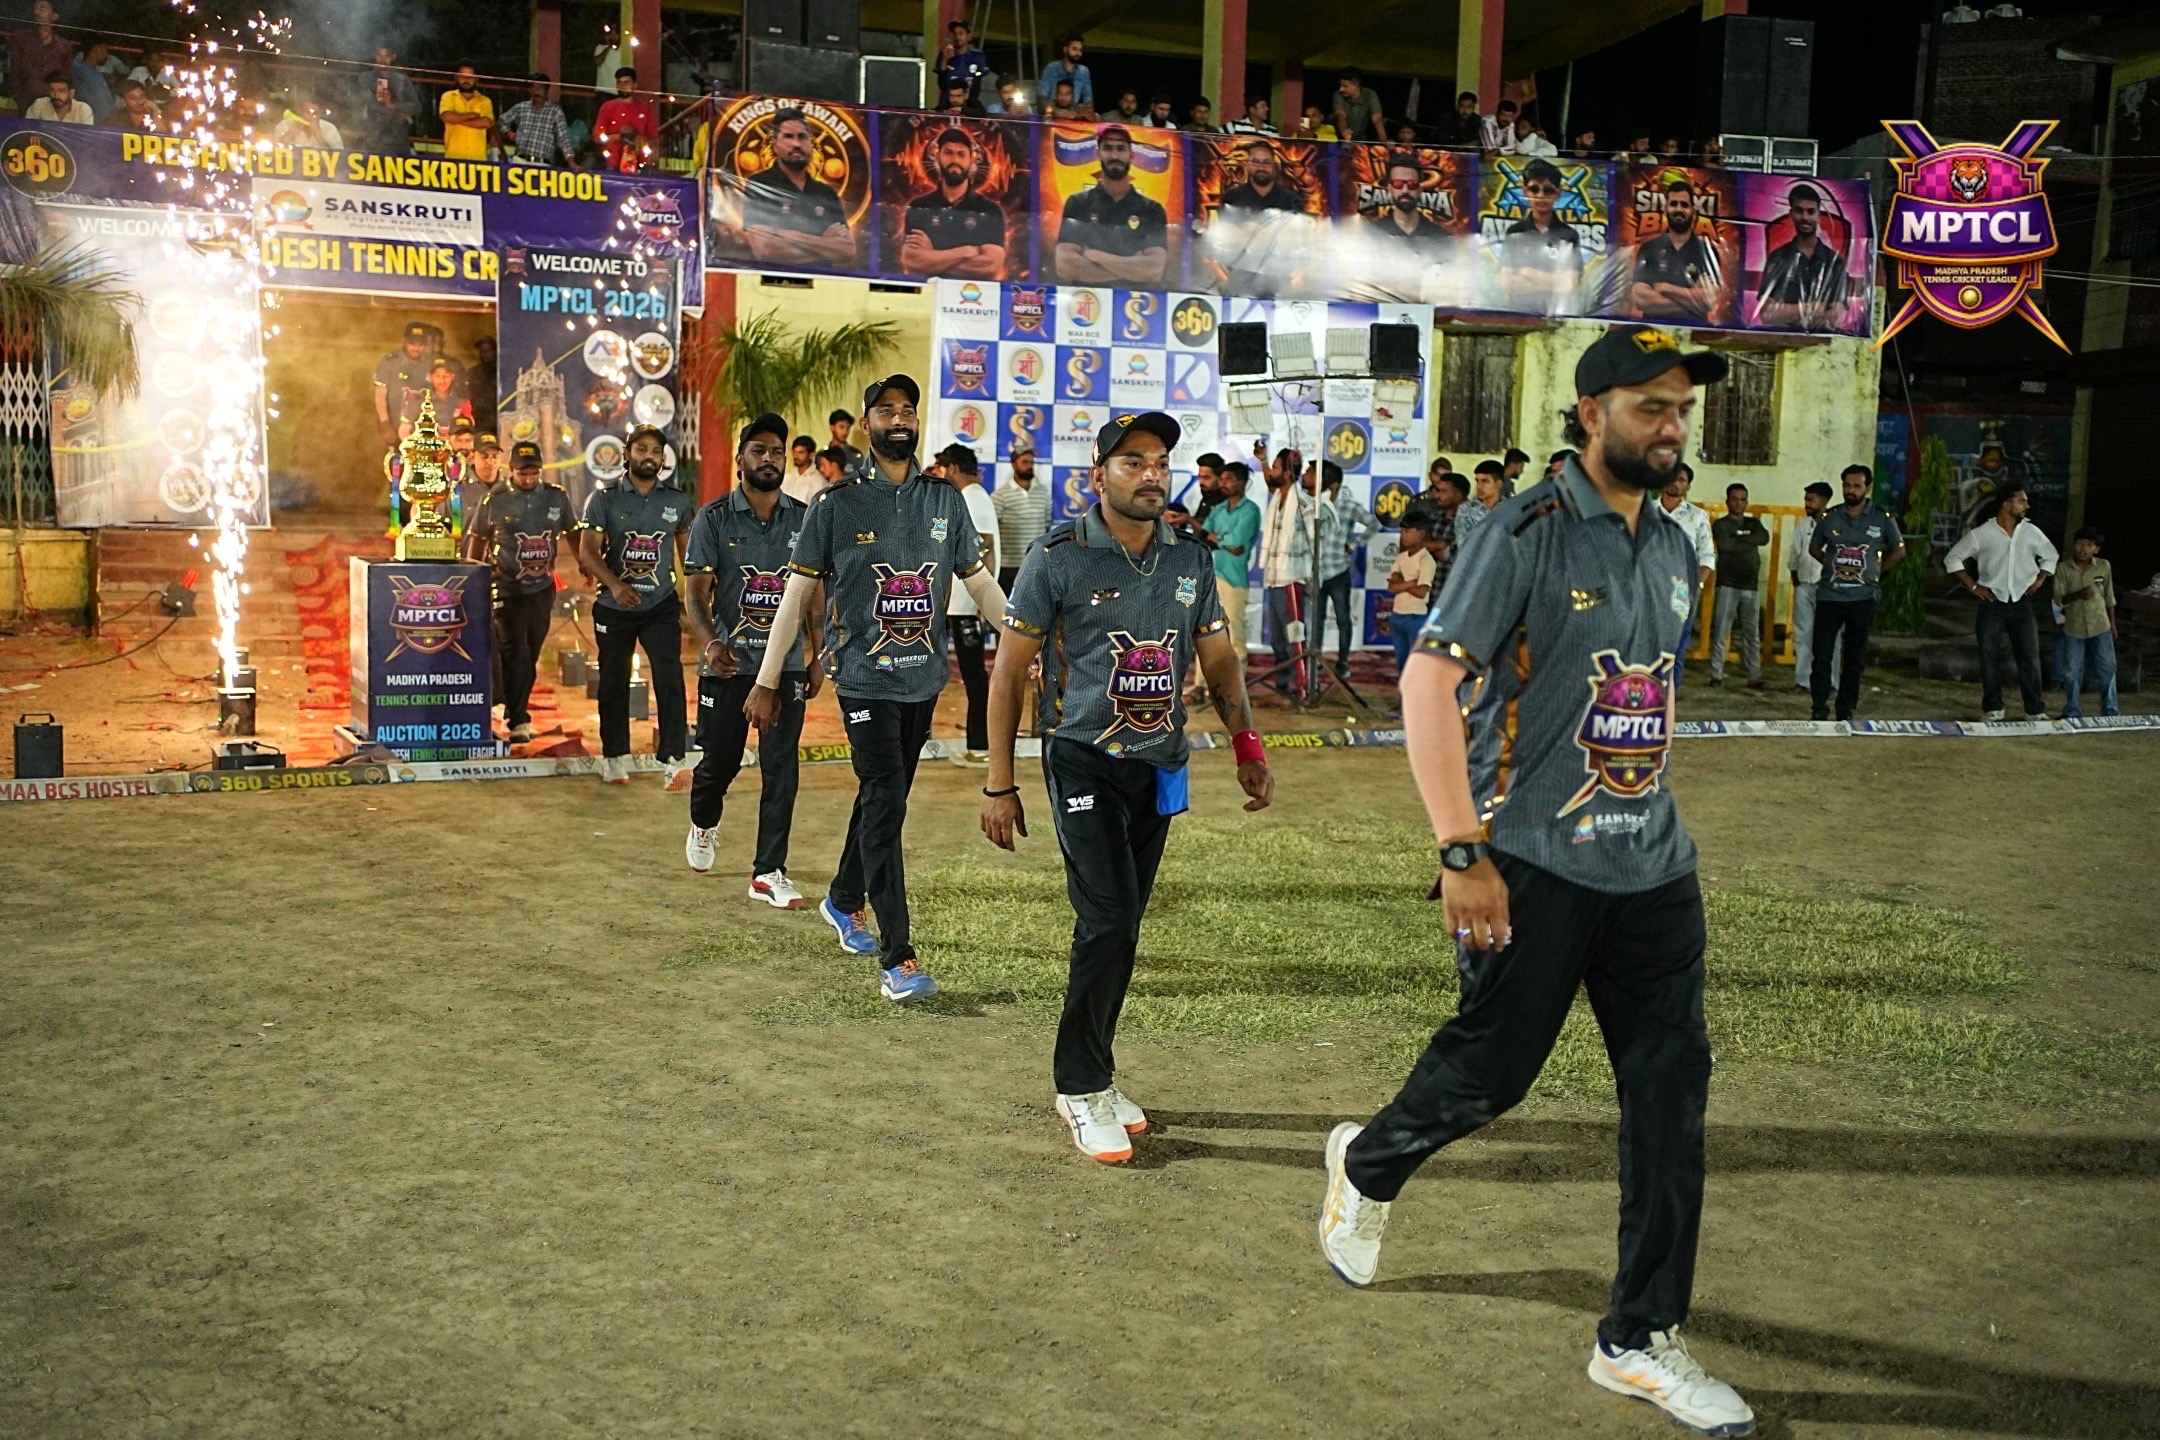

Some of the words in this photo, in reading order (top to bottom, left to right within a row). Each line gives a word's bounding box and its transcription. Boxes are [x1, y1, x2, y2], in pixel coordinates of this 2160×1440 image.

[728, 98, 775, 134] KINGS
[802, 102, 854, 142] AWARI
[8, 145, 66, 182] 360
[122, 133, 293, 176] PRESENTED
[302, 150, 339, 178] BY
[348, 153, 500, 193] SANSKRUTI
[508, 167, 608, 202] SCHOOL
[325, 198, 472, 221] SANSKRUTI
[637, 211, 680, 225] MPTCL
[77, 217, 183, 238] WELCOME
[349, 242, 456, 279] TENNIS
[532, 253, 621, 275] WELCOME
[624, 260, 647, 277] TO
[521, 285, 598, 315] MPTCL
[604, 290, 666, 319] 2026
[1013, 304, 1044, 316] MPTCL
[943, 306, 998, 317] SANSKRUTI
[1174, 306, 1213, 336] 360
[1111, 378, 1165, 388] SANSKRUTI
[1329, 430, 1365, 459] 360
[1373, 447, 1421, 455] SANSKRUTI
[625, 550, 657, 560] MPTCL
[881, 599, 930, 613] MPTCL
[397, 609, 461, 623] MPTCL
[387, 674, 428, 686] MADHYA
[429, 673, 472, 685] PRADESH
[1118, 676, 1173, 692] MPTCL
[375, 694, 409, 706] TENNIS
[410, 694, 448, 705] CRICKET
[449, 693, 484, 705] LEAGUE
[377, 725, 437, 743] AUCTION
[441, 723, 481, 740] 2026
[1592, 715, 1666, 741] MPTCL
[1263, 733, 1324, 748] SPORTS
[469, 746, 496, 759] LEAGUE
[441, 765, 527, 776] SANSKRUTI
[220, 776, 262, 792] 360
[269, 770, 352, 789] SPORTS
[0, 784, 39, 801] MAA
[46, 782, 80, 800] BCS
[88, 780, 156, 798] HOSTEL
